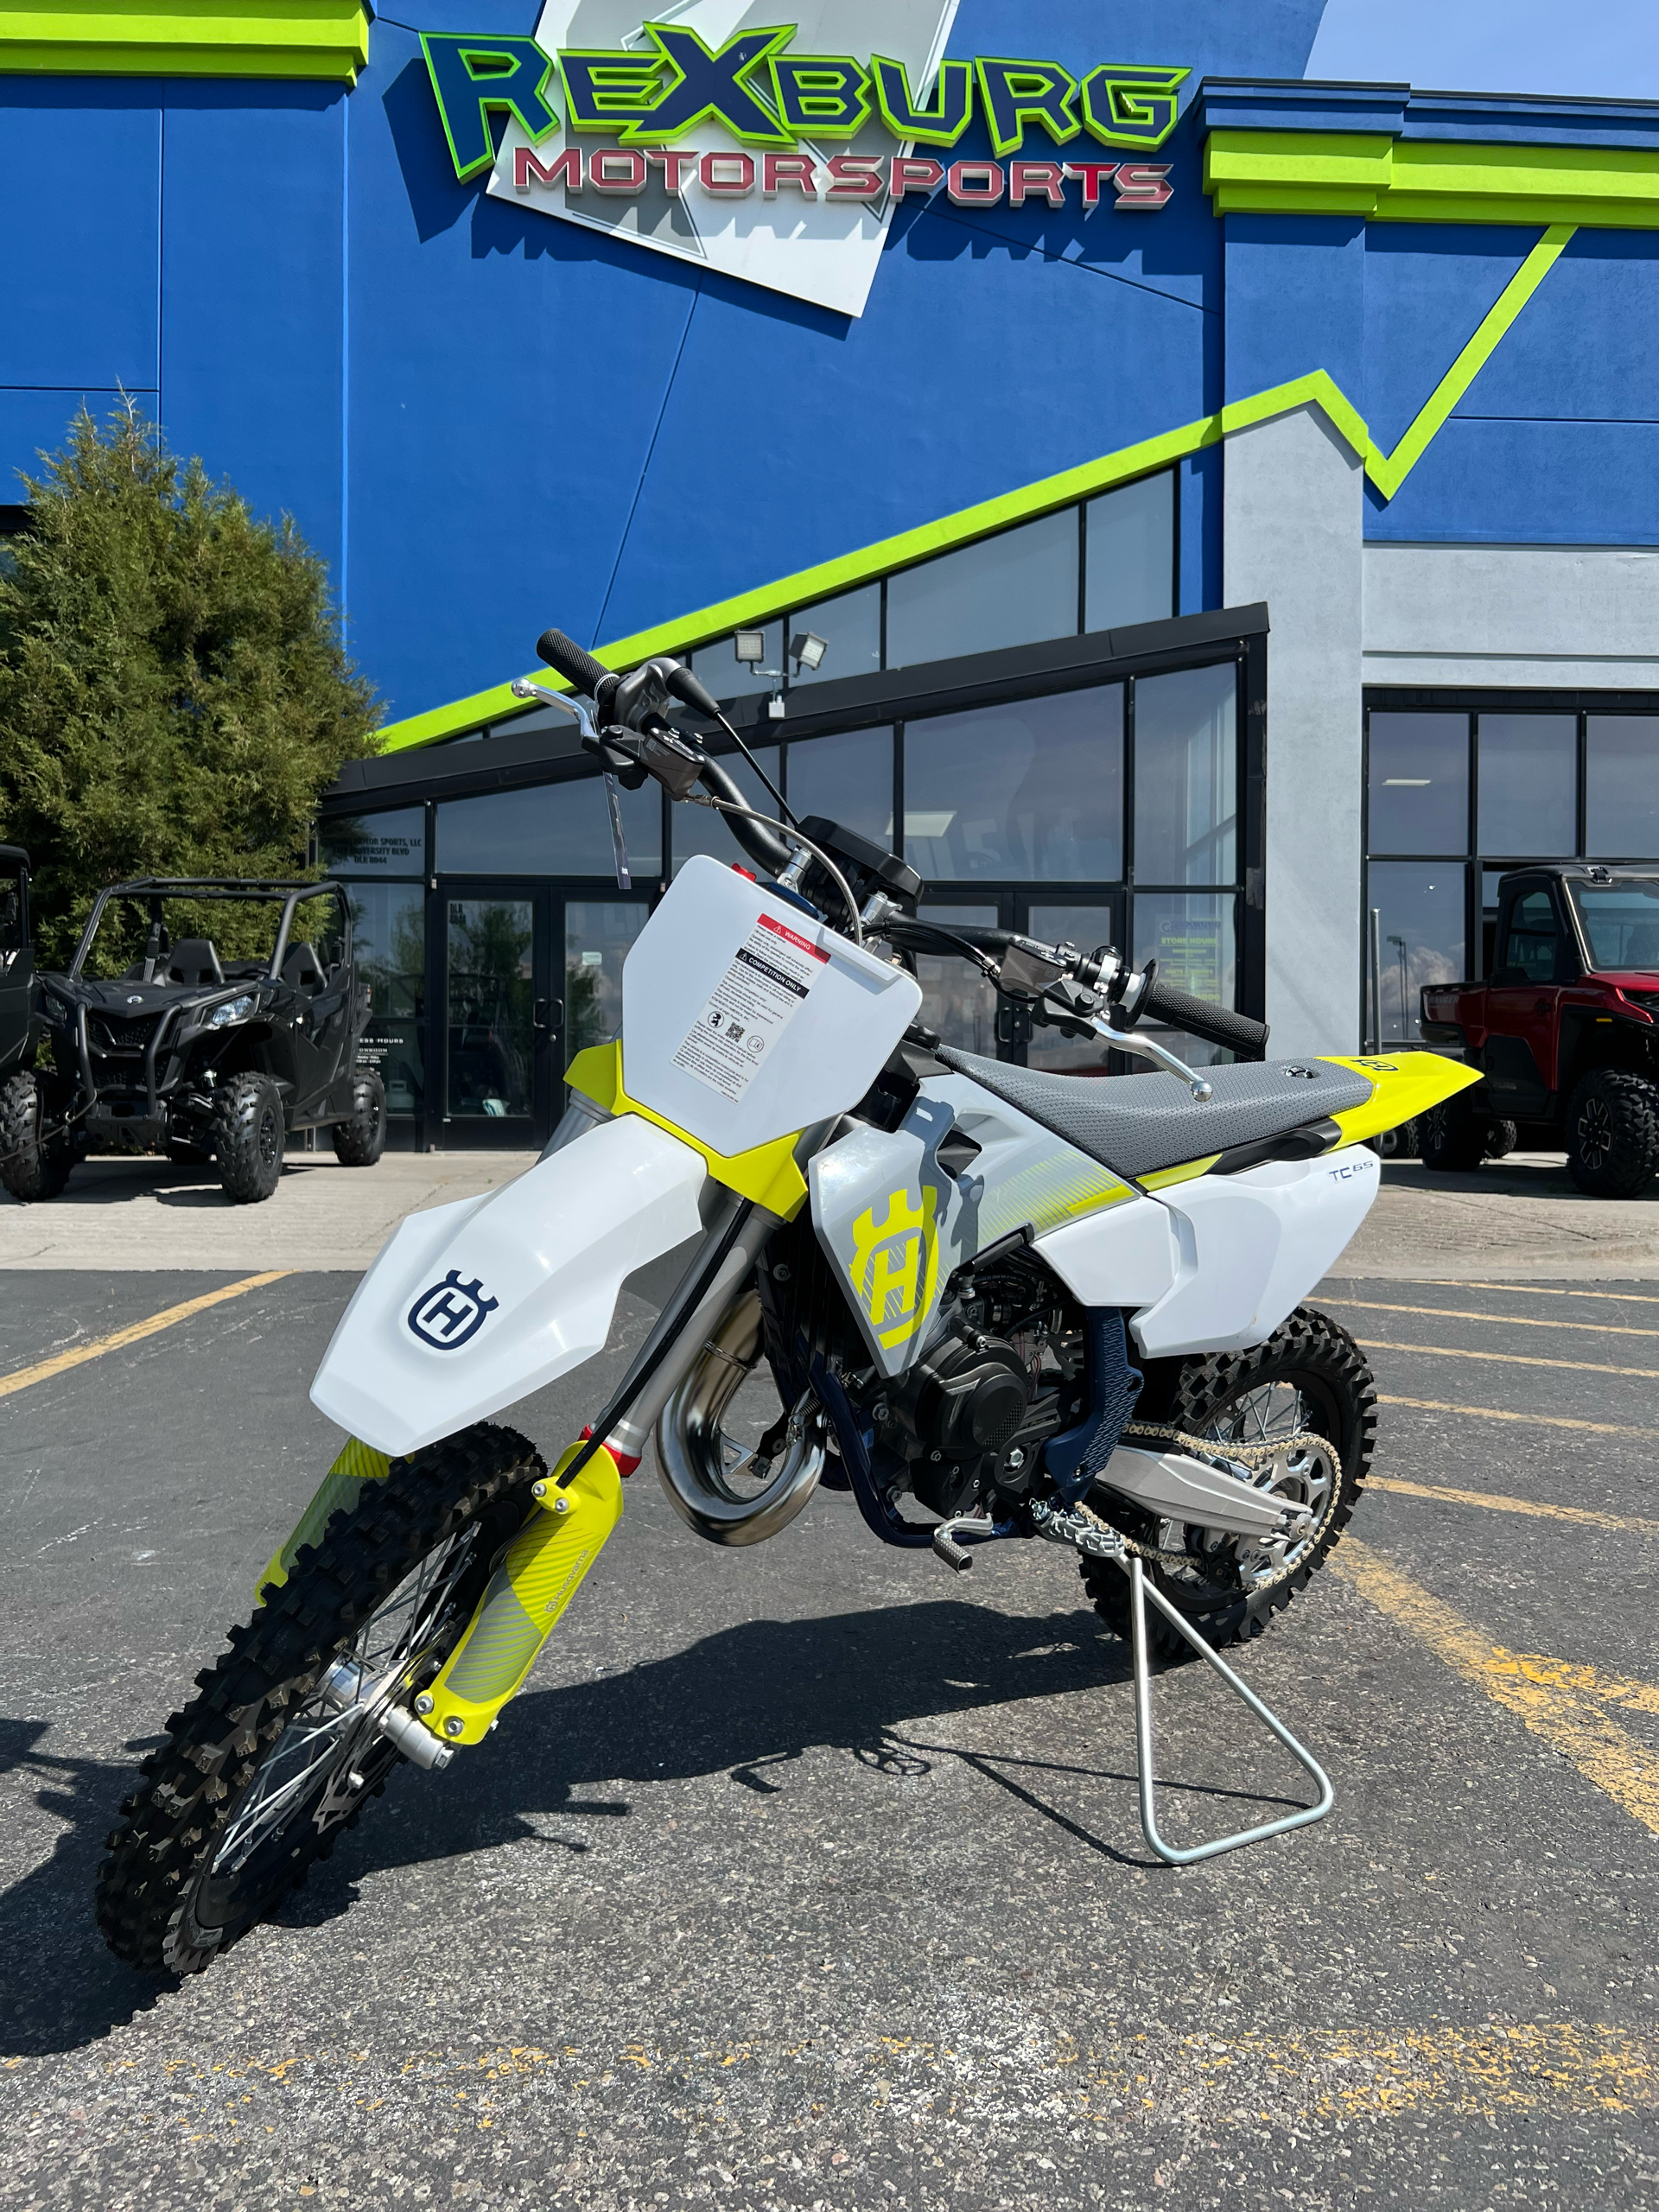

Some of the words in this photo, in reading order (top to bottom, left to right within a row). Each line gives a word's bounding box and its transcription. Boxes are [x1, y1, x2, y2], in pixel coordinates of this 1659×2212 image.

[419, 22, 1192, 184] REXBURG
[513, 146, 1173, 211] MOTORSPORTS
[410, 838, 423, 847] LLC
[354, 855, 368, 864] DLR
[449, 903, 463, 913] DLR
[783, 930, 811, 950] WARNING
[747, 957, 786, 983] COMPETITION
[784, 979, 801, 992] ONLY
[1329, 1167, 1352, 1181] TC
[1353, 1160, 1373, 1172] 65
[554, 1550, 588, 1600] Husqvarna
